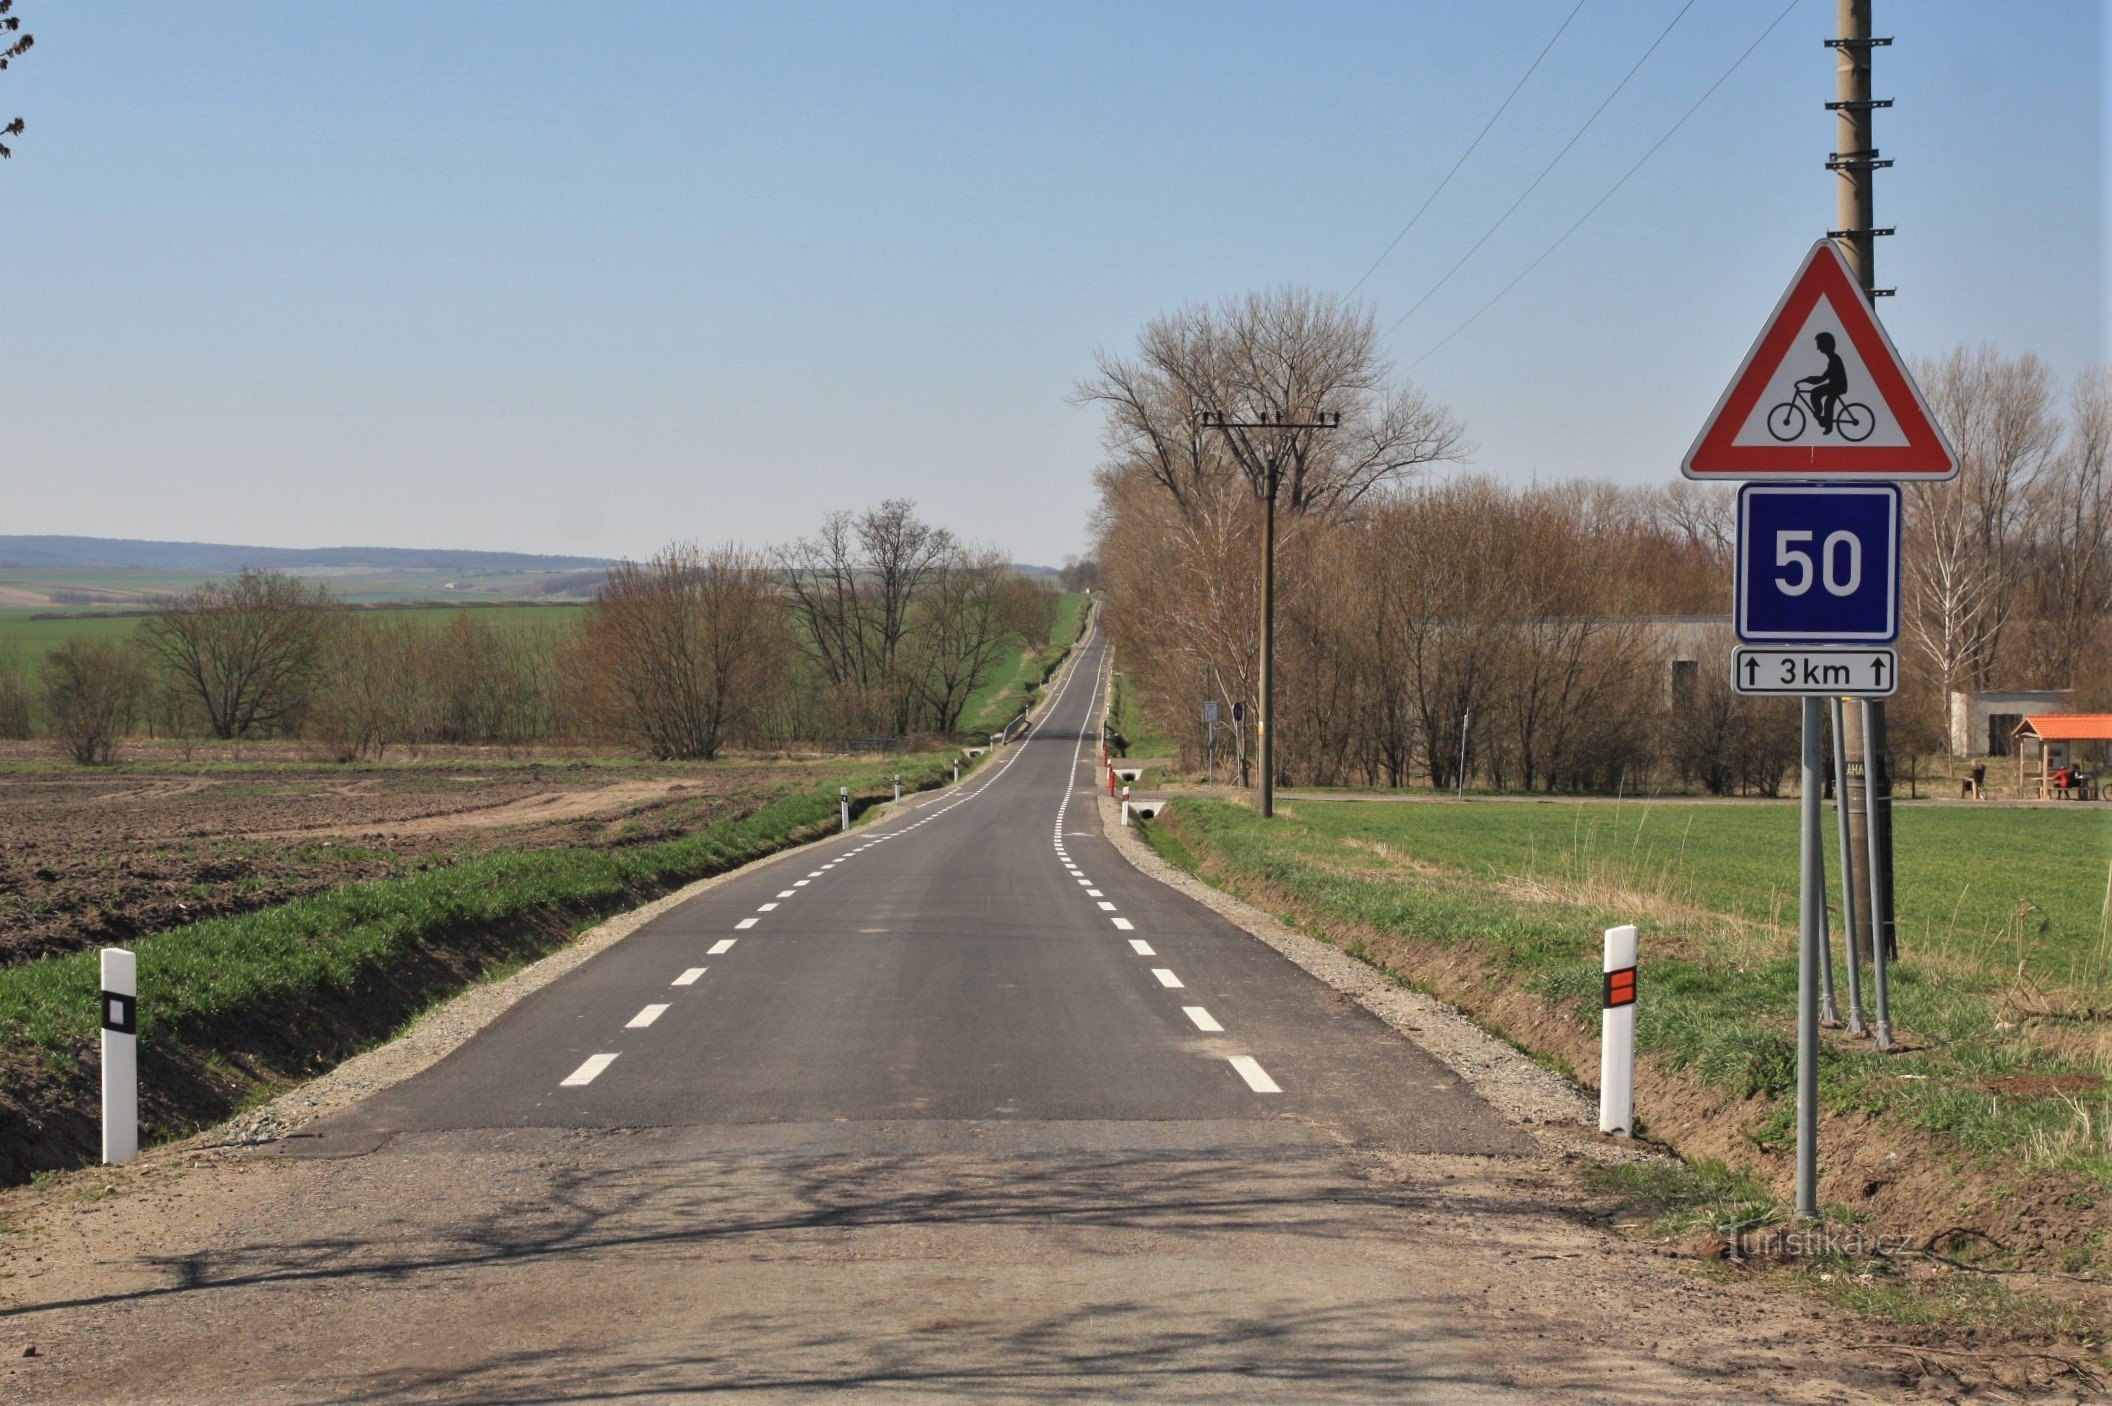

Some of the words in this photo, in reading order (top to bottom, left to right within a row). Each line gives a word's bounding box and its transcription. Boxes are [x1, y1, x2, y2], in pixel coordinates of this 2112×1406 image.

[1775, 530, 1862, 597] 50
[1780, 658, 1796, 685] 3
[1803, 657, 1850, 685] km
